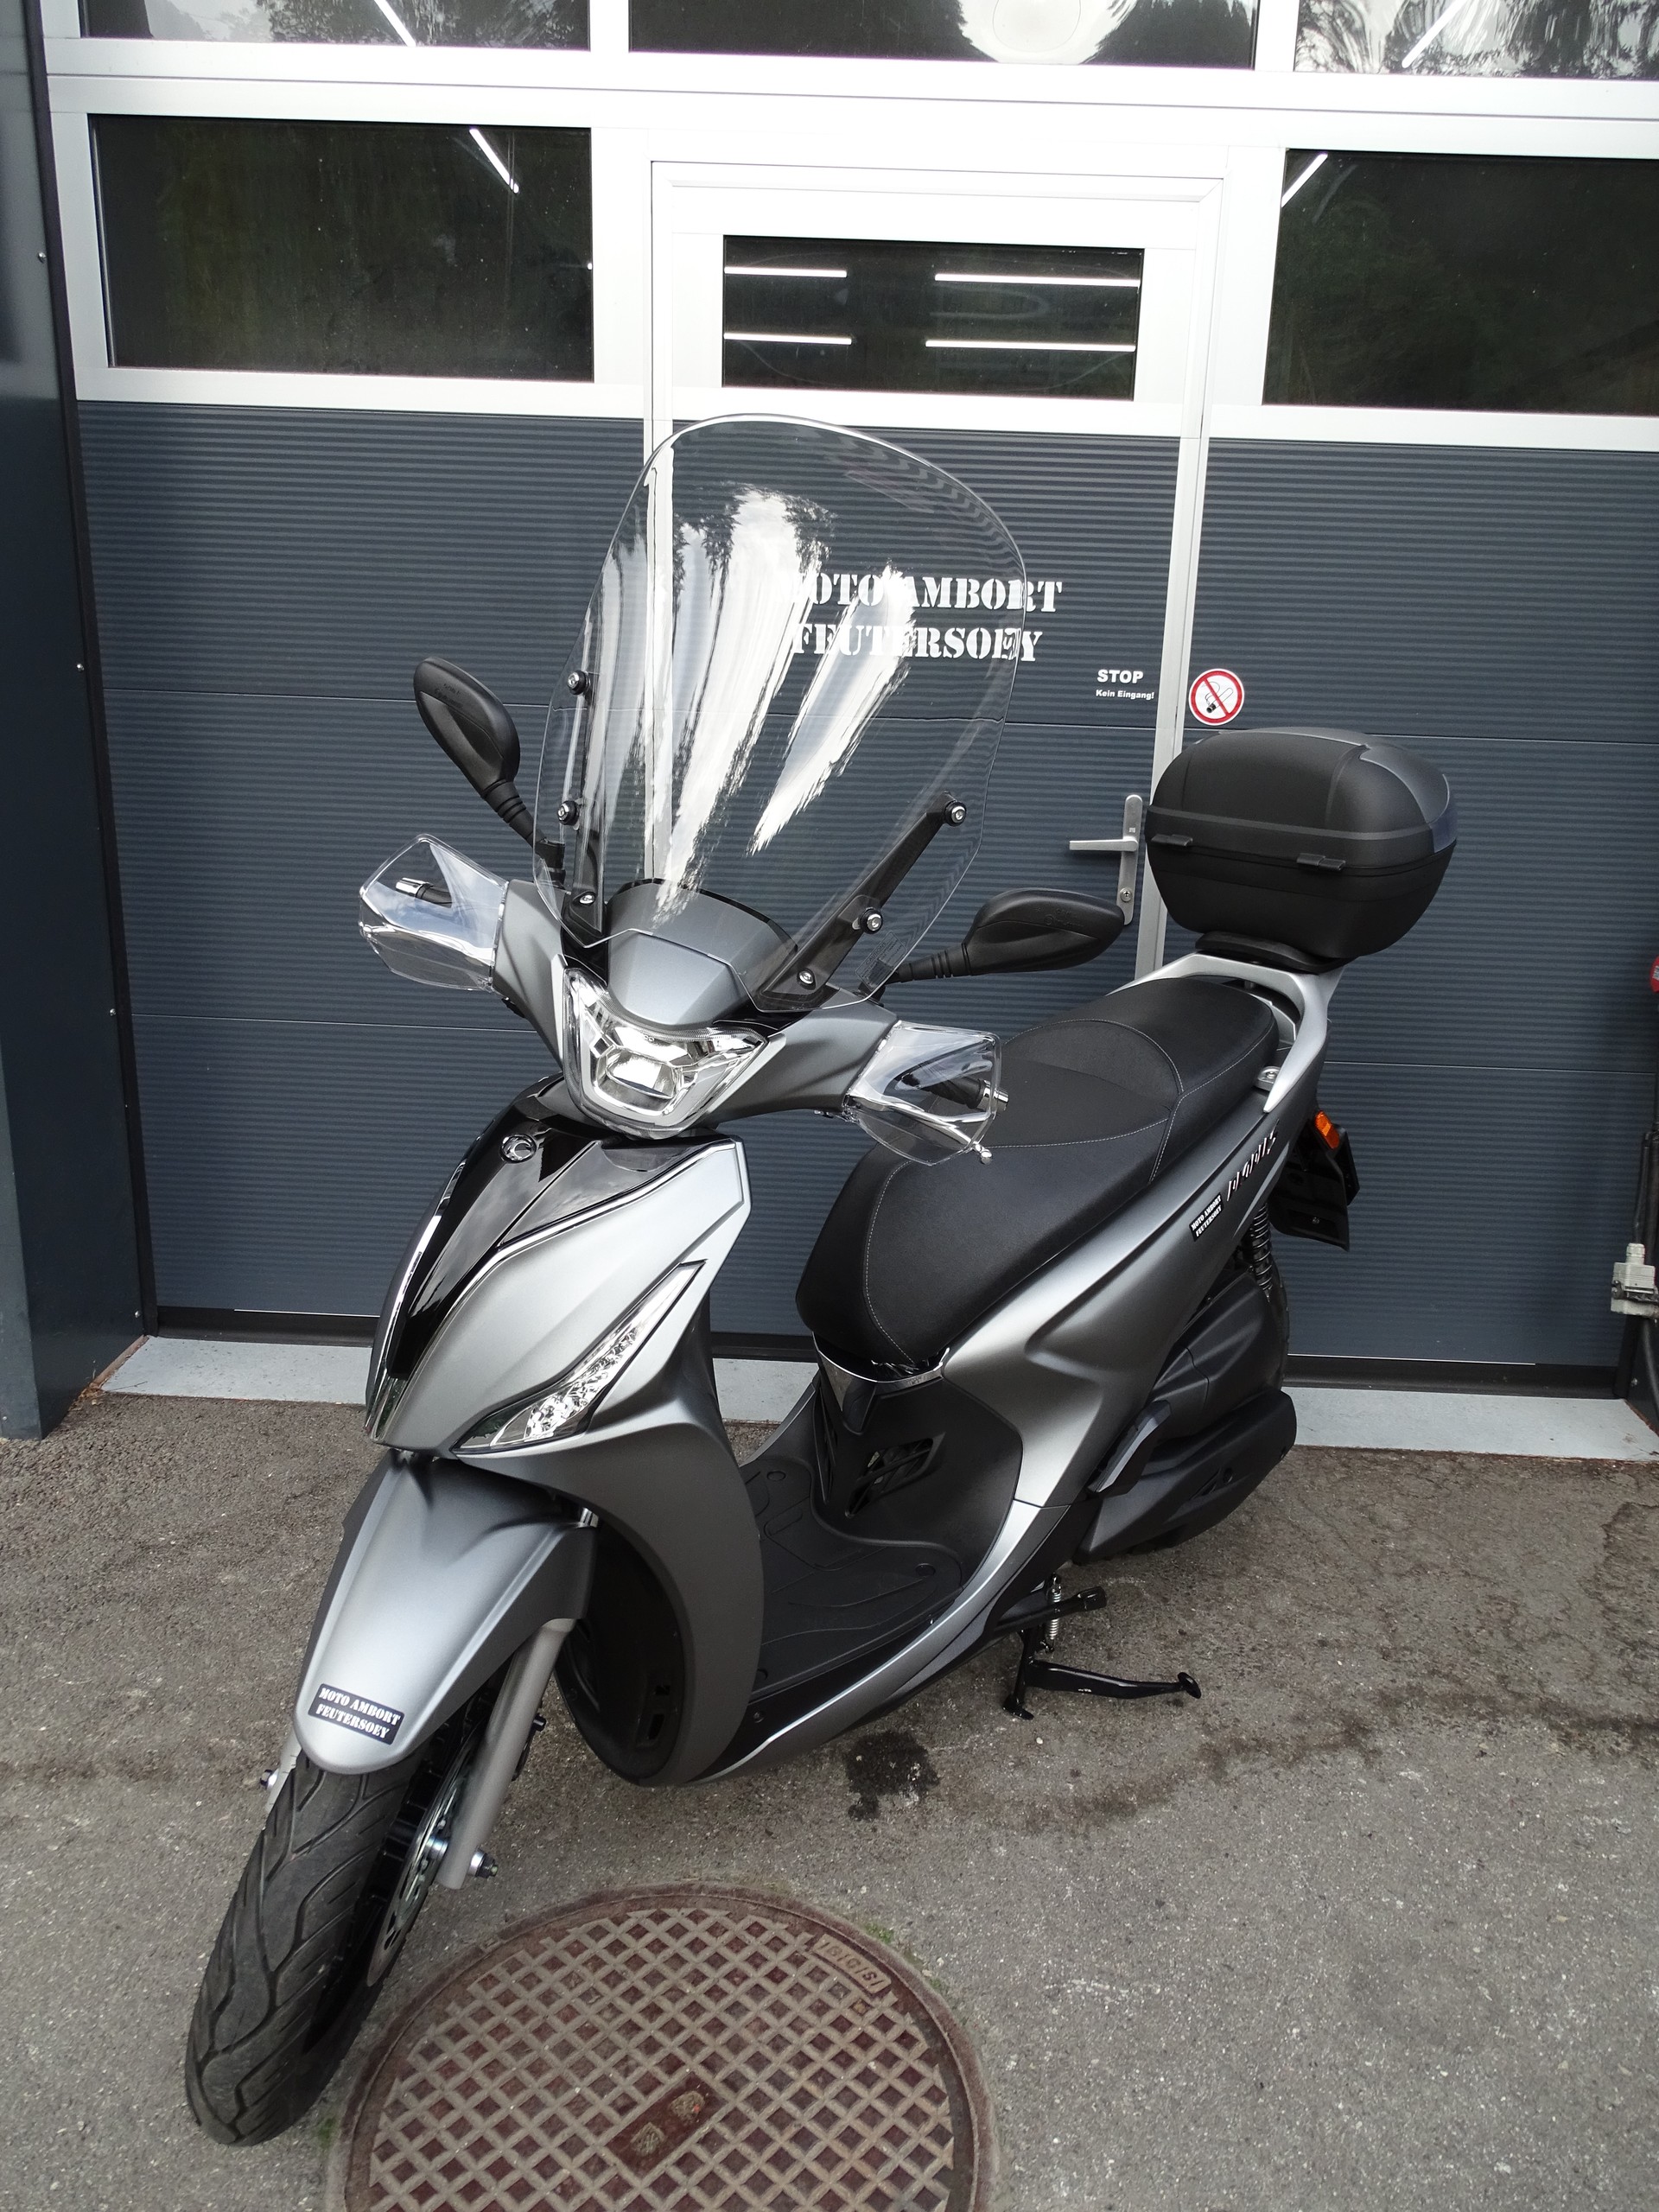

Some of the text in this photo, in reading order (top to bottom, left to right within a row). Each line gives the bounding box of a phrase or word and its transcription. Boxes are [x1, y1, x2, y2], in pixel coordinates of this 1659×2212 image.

[790, 572, 1063, 613] OTO AMBORT
[1096, 669, 1144, 683] STOP
[1117, 690, 1154, 701] Eingang!
[1191, 1194, 1223, 1231] MOTO AMBORT
[315, 1703, 391, 1738] FEUTERSOEY
[318, 1688, 402, 1726] MOTO AMBORT
